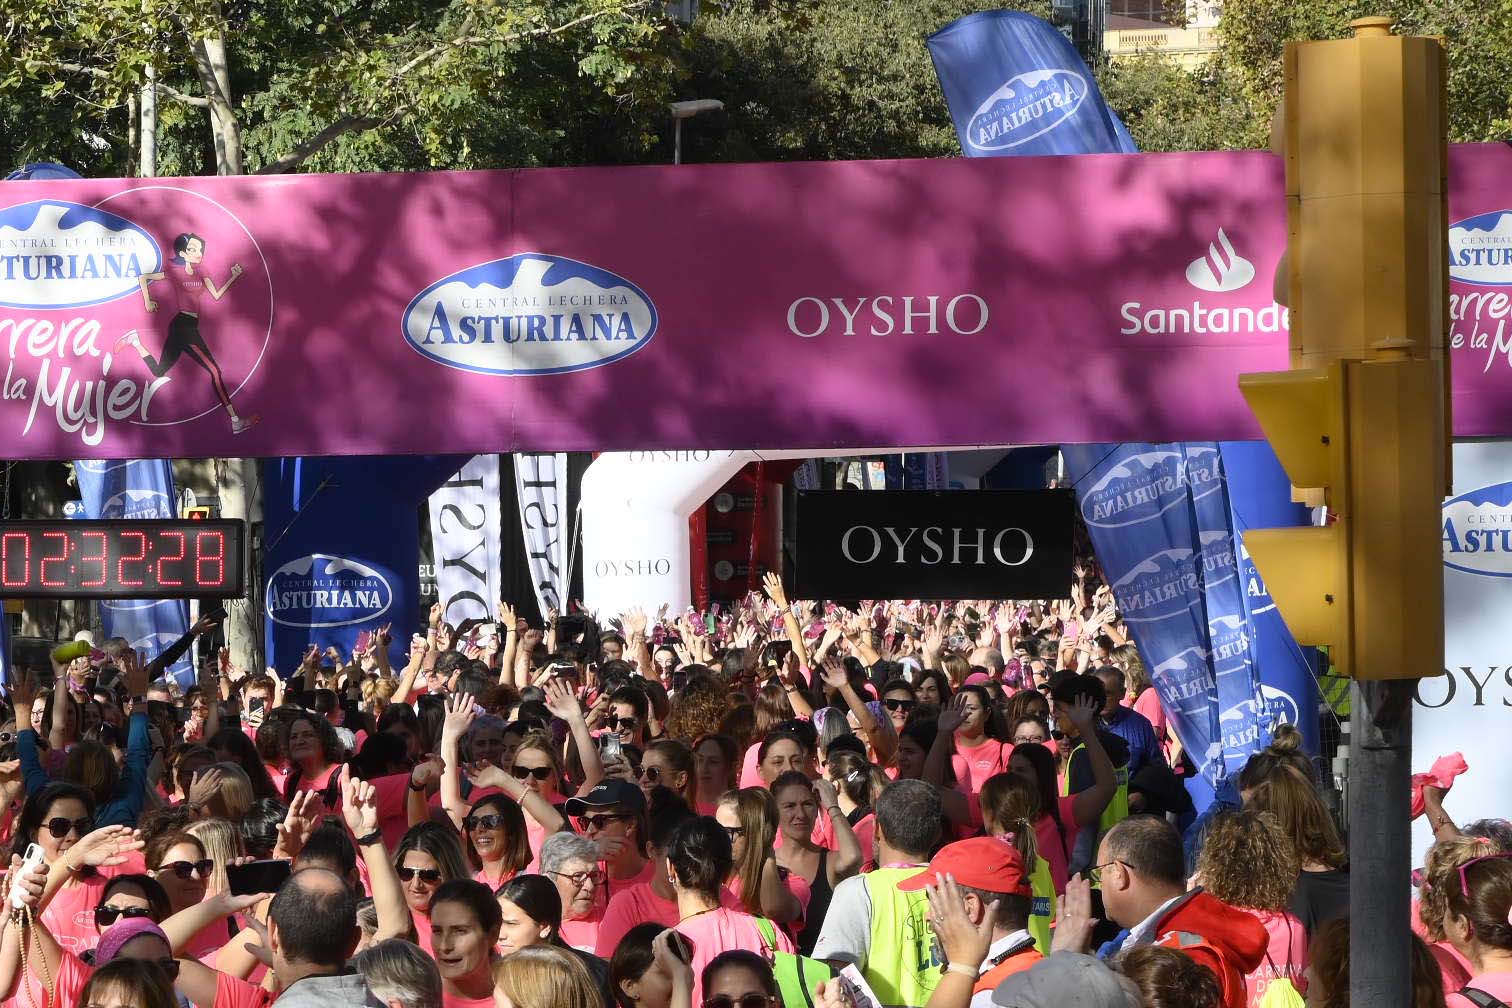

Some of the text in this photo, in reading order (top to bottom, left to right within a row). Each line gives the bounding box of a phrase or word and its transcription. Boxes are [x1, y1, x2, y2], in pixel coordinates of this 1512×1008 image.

[461, 295, 630, 309] CENTRAL LECHERA
[788, 293, 989, 338] OYSHO
[423, 301, 638, 346] ASTURIANA
[1470, 321, 1488, 349] la
[3, 356, 27, 400] la
[22, 355, 172, 446] Mujer
[1467, 514, 1512, 523] CENT
[2, 532, 225, 586] 02:32:28
[841, 525, 1034, 567] OYSHO
[595, 558, 671, 577] OYSHO
[271, 584, 383, 612] ASTURIANA
